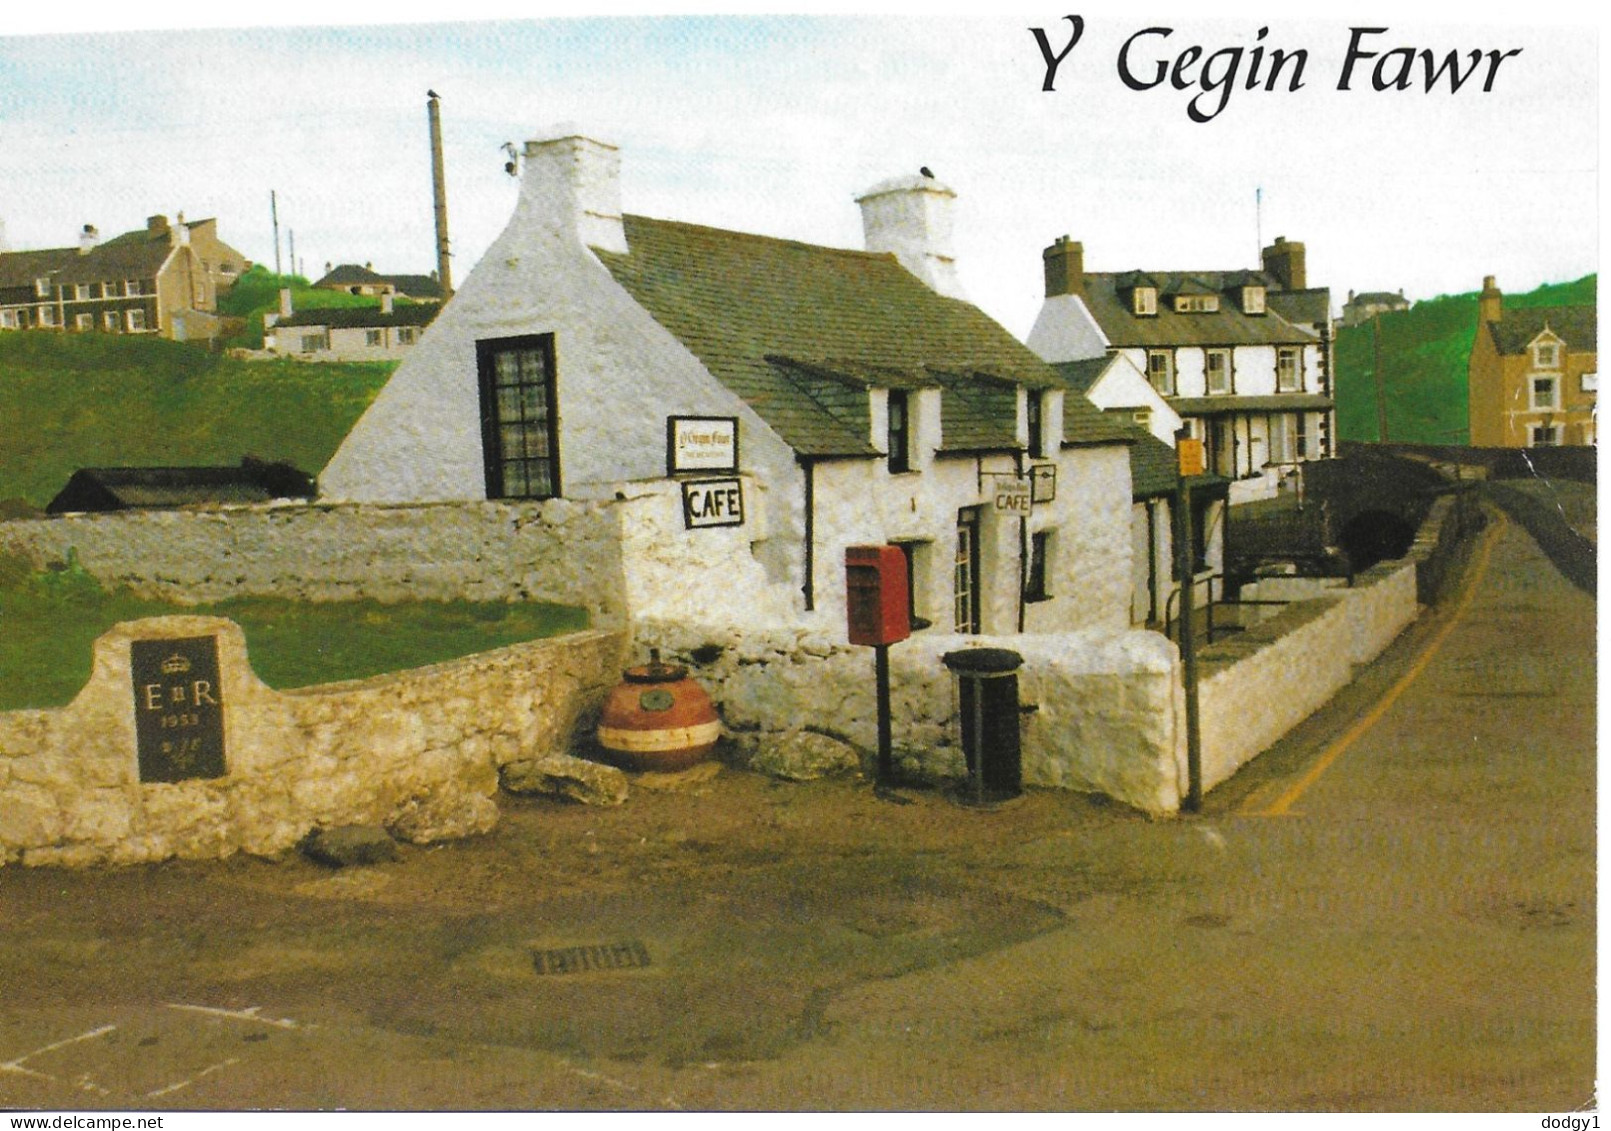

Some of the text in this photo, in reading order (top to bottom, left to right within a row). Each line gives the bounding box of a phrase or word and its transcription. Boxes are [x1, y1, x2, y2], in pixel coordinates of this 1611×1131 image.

[689, 488, 739, 517] CAFE
[996, 494, 1029, 511] CAFE
[146, 683, 162, 710] E
[194, 680, 217, 706] R
